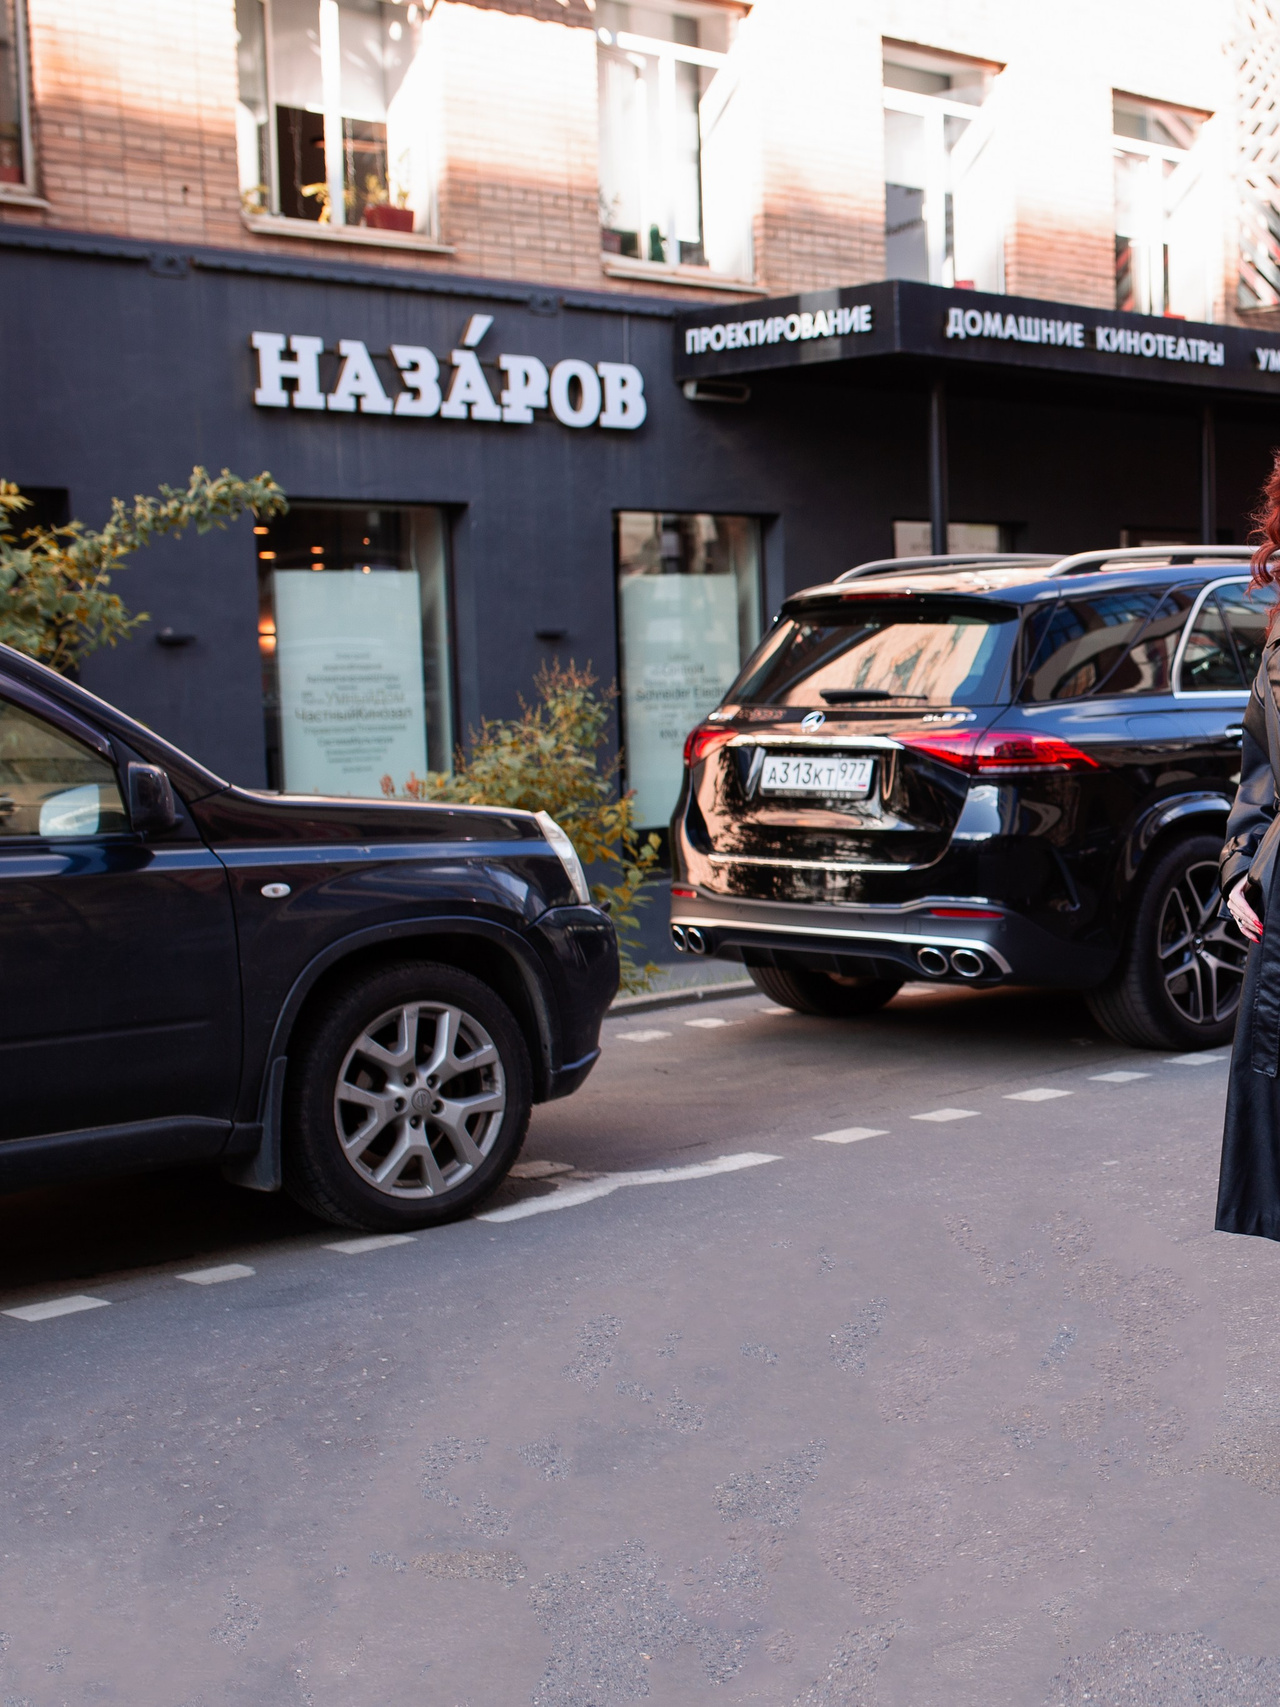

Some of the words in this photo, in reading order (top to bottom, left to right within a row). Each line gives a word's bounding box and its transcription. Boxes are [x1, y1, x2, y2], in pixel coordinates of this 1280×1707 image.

[685, 304, 873, 355] ПРОЕКТИРОВАНИЕ
[945, 307, 1085, 349] ДОМАШНИЕ
[1095, 325, 1225, 367] КИНОТЕАТРЫ
[840, 762, 867, 781] 977
